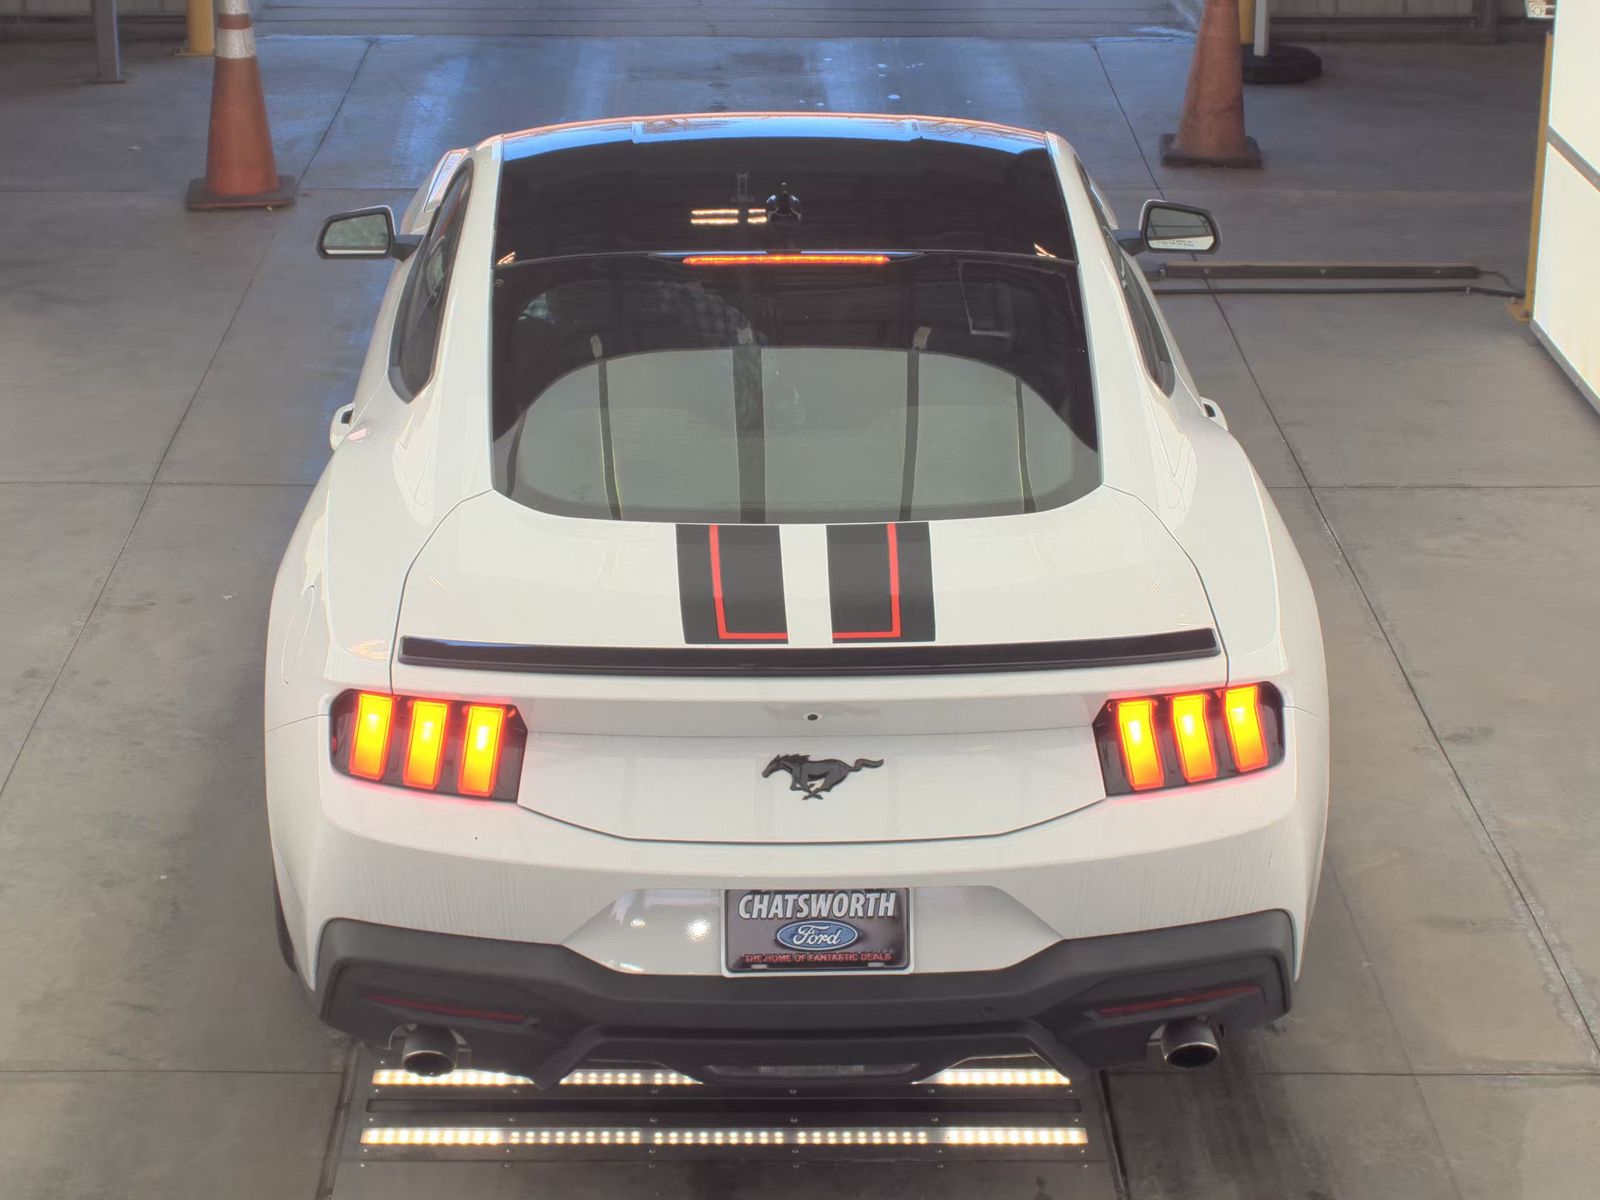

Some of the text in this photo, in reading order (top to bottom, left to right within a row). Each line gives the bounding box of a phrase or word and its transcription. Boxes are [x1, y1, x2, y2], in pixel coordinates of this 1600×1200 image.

[738, 892, 897, 919] CHATSWORTH
[793, 924, 841, 945] Ford
[745, 953, 892, 963] THE HOME OF FANTASTIC DEALS
